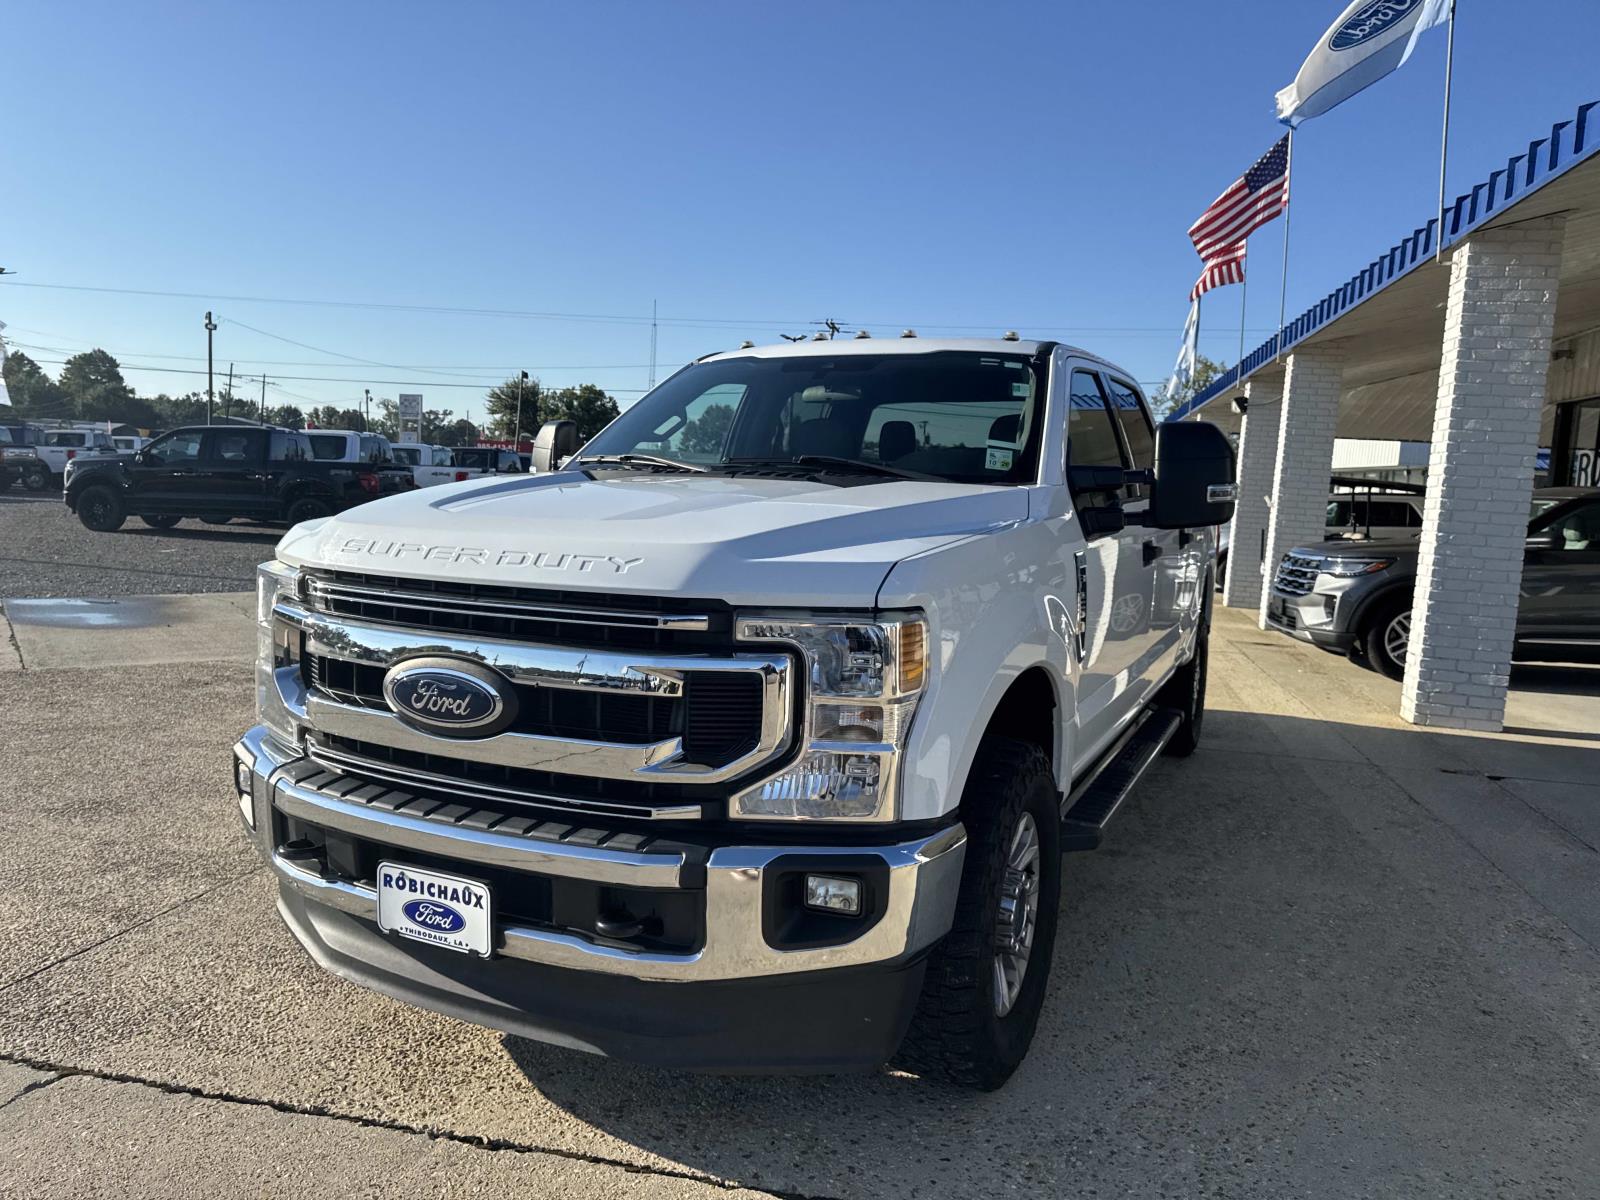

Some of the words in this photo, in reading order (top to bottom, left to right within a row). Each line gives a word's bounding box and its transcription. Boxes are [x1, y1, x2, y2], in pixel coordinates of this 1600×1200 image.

[341, 538, 489, 565] SUPER
[495, 549, 645, 574] DUTY
[411, 679, 472, 715] Ford
[383, 873, 484, 910] ROBICHAUX
[415, 903, 453, 929] Ford
[453, 939, 463, 947] LA
